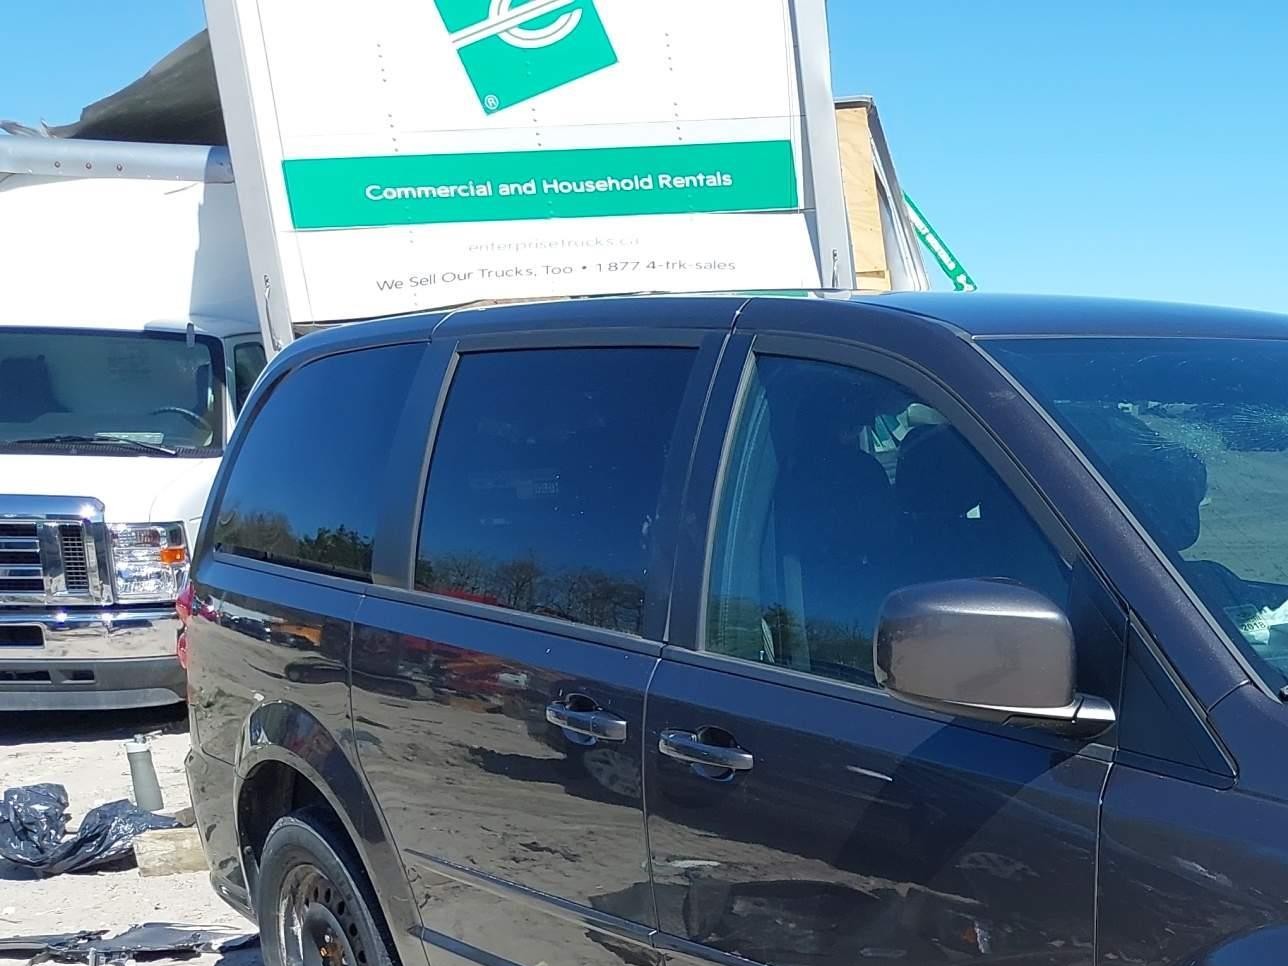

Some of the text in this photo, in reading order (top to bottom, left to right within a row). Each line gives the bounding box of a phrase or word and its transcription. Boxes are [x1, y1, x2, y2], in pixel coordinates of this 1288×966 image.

[365, 171, 733, 200] Commercial and Household Rentals
[376, 279, 404, 291] We
[409, 274, 436, 288] Sell
[441, 270, 474, 283] Our
[479, 266, 537, 280] Trucks,
[543, 265, 573, 276] Too
[608, 262, 640, 272] 877
[645, 259, 736, 271] 4-trk-sales
[1241, 621, 1266, 631] 2018
